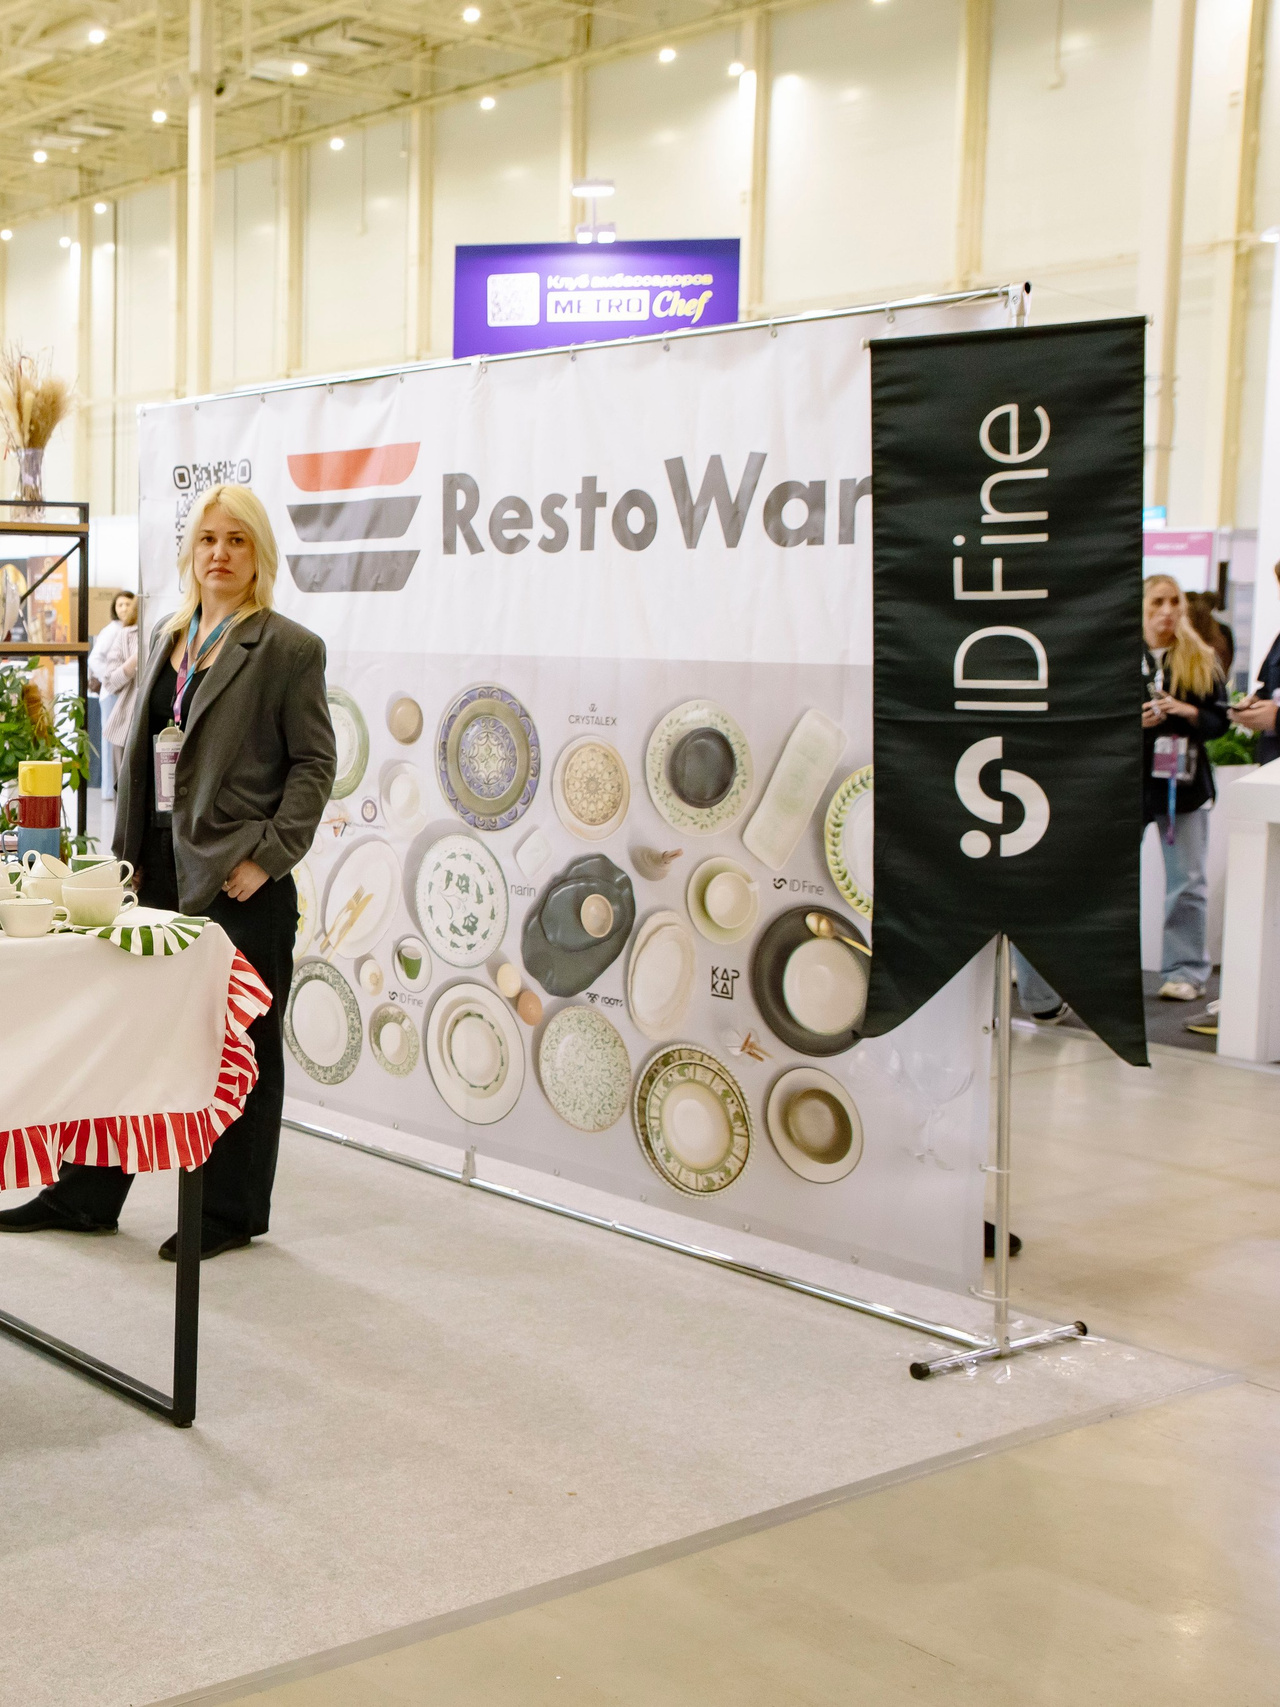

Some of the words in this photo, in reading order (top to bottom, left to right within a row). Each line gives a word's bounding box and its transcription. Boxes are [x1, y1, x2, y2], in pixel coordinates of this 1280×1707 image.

[554, 298, 642, 314] METRO
[652, 290, 713, 324] Chef
[441, 451, 872, 556] RestoWar
[952, 402, 1051, 599] Fine
[953, 624, 1049, 711] ID
[568, 714, 617, 726] CRYSTALEX
[510, 883, 536, 897] narin
[789, 879, 800, 892] ID
[802, 880, 824, 896] Fine
